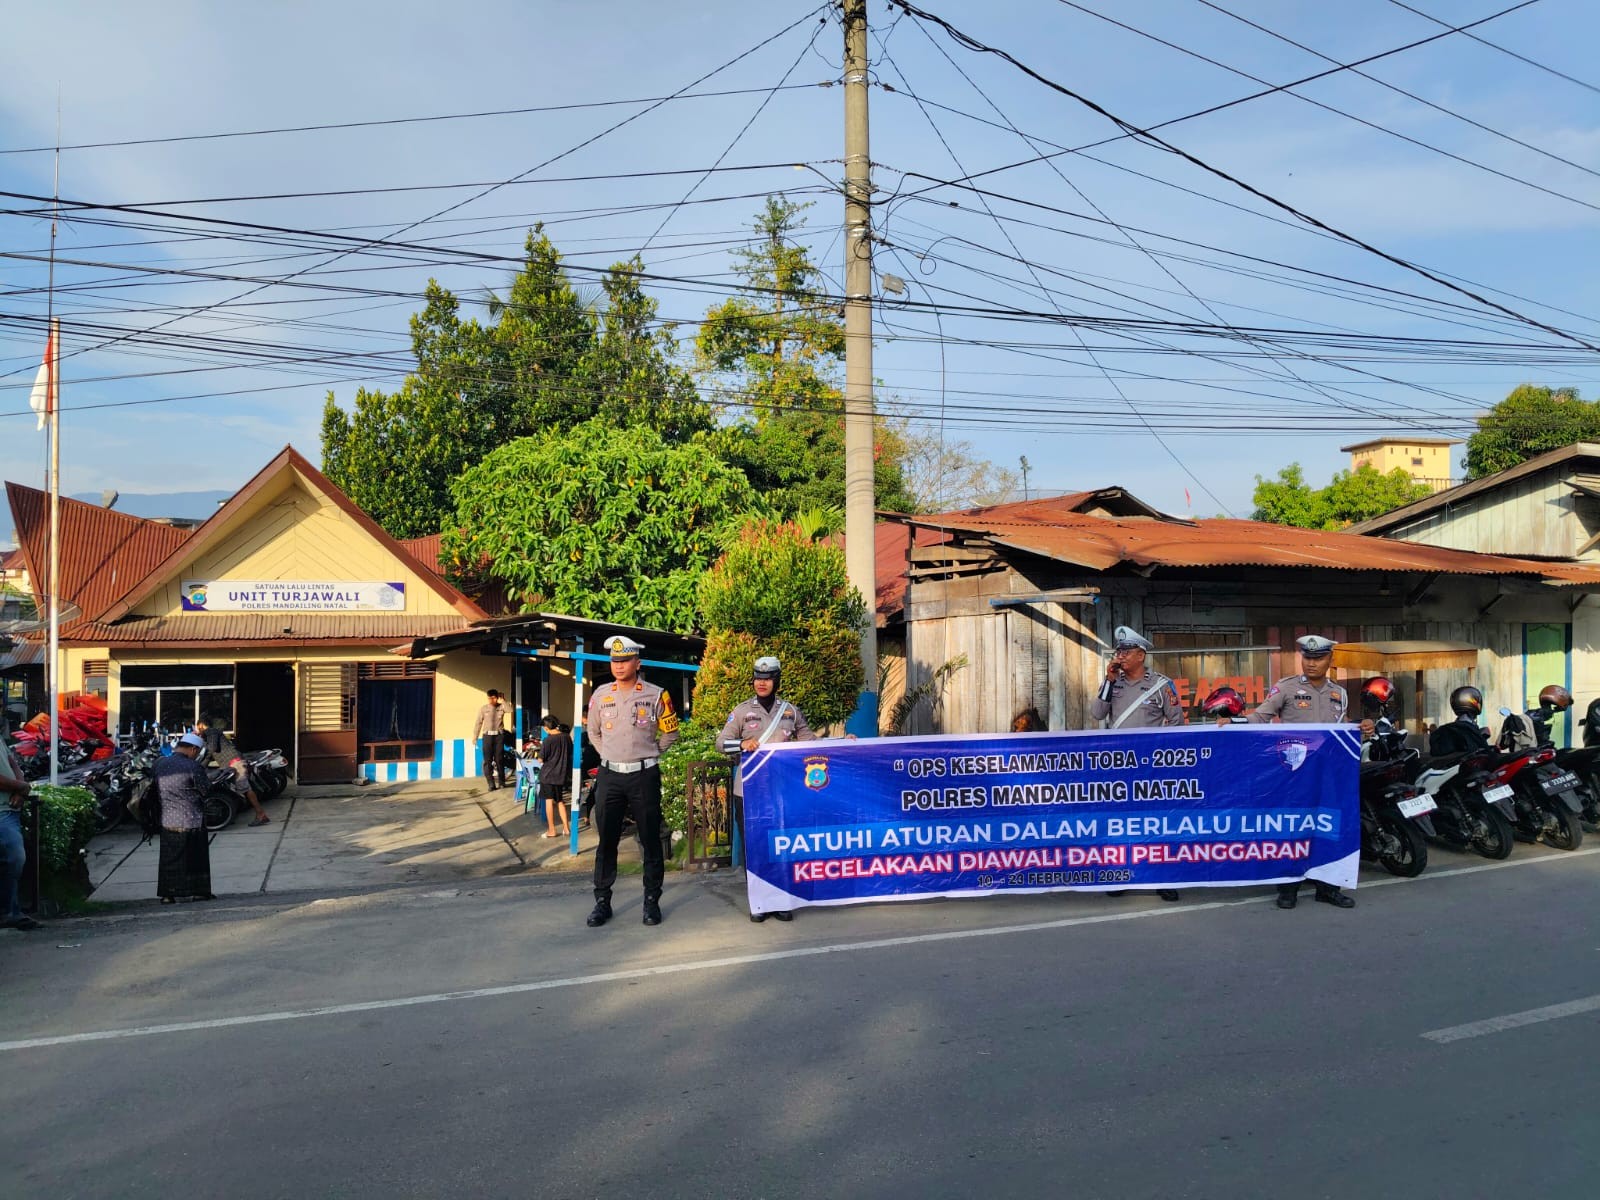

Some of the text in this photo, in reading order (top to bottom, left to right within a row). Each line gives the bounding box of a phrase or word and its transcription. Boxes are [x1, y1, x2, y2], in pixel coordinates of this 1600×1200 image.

[229, 591, 360, 601] UNIT TURJAWALI
[908, 757, 946, 777] OPS
[951, 751, 1083, 776] KESELAMATAN
[1088, 749, 1137, 769] TOBA
[1152, 747, 1197, 767] 2025
[901, 779, 1204, 811] POLRES MANDAILING NATAL
[774, 813, 1333, 855] PATUHI ATURAN DALAM BERLALU LINTAS
[793, 840, 1311, 882] KECELAKAAN DIAWALI DARI PELANGGARAN
[1027, 870, 1095, 885] FEBRUARI
[1099, 869, 1130, 882] 2025
